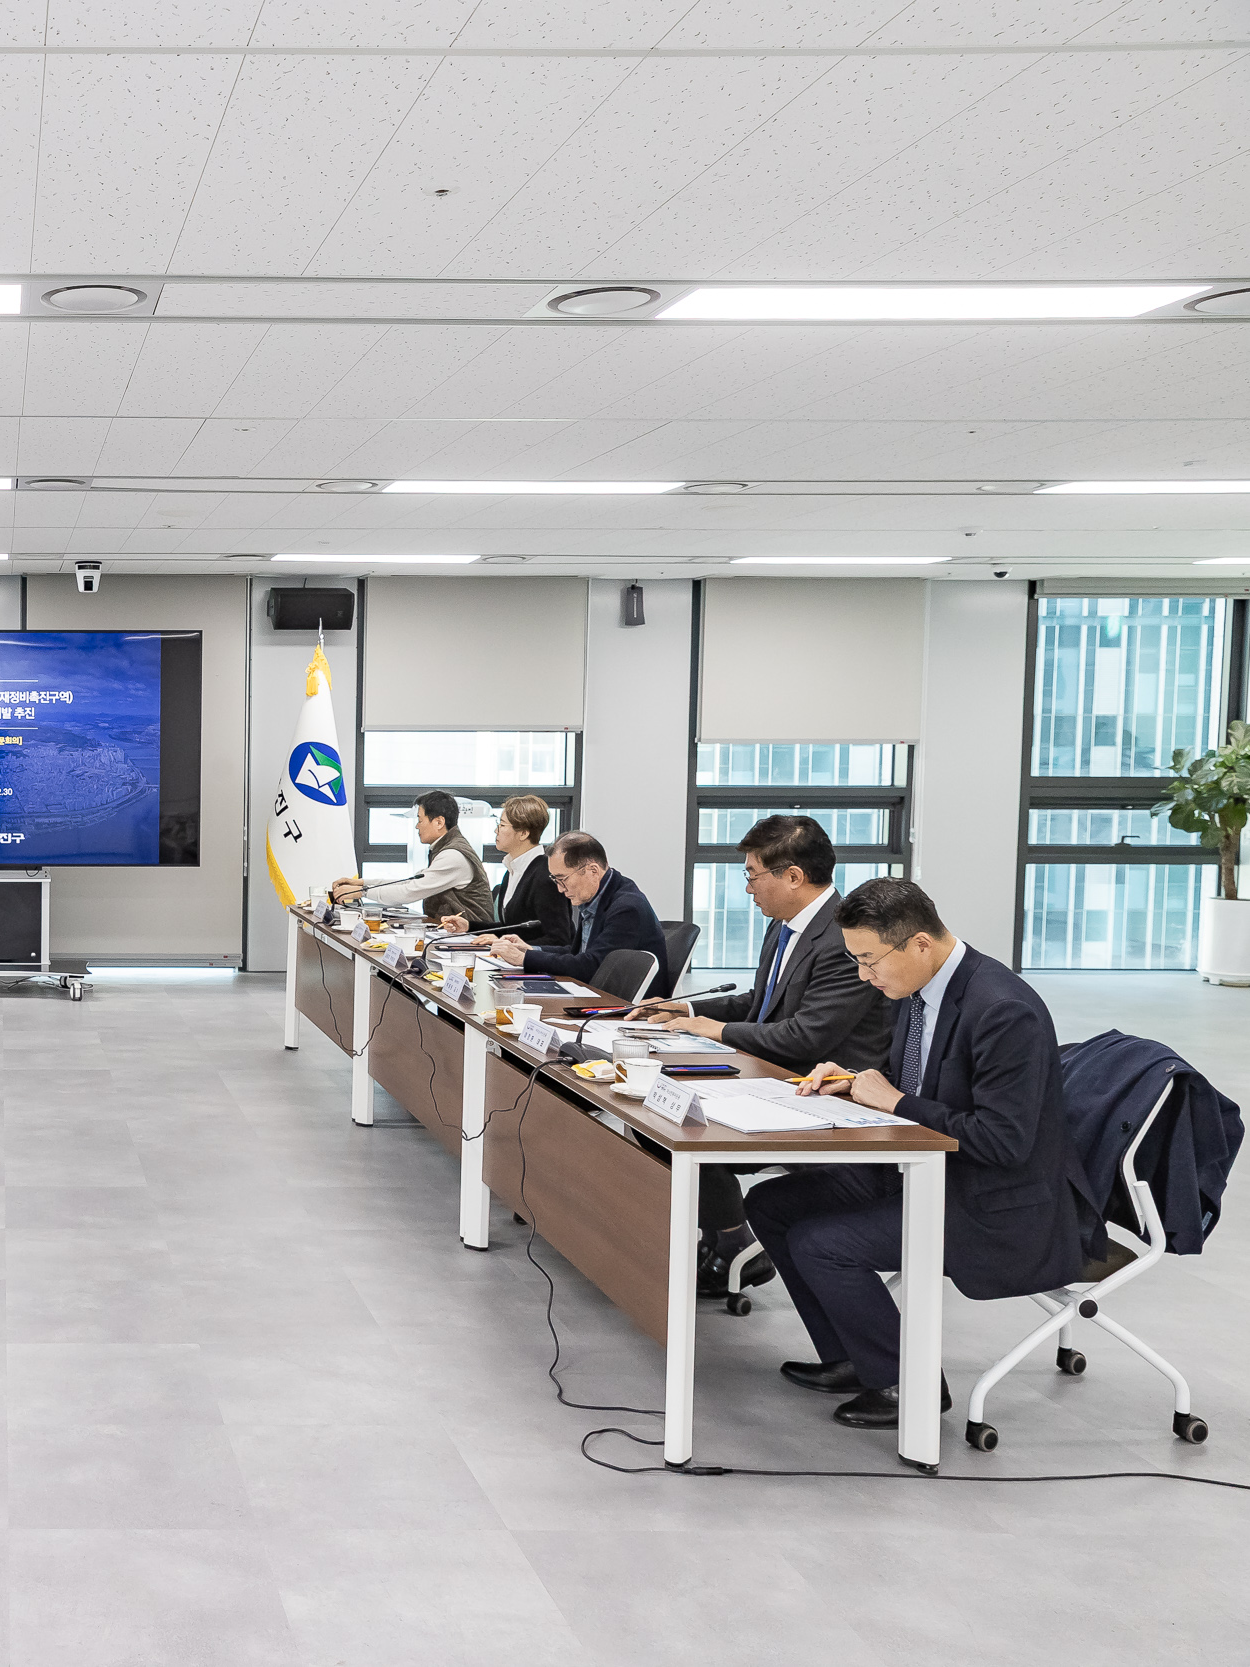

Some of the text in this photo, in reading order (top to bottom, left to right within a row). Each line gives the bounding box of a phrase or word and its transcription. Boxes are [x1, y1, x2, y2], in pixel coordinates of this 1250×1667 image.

[0, 690, 73, 704] 재정비촉진구역)
[14, 707, 35, 719] 추진
[274, 778, 303, 843] 진구
